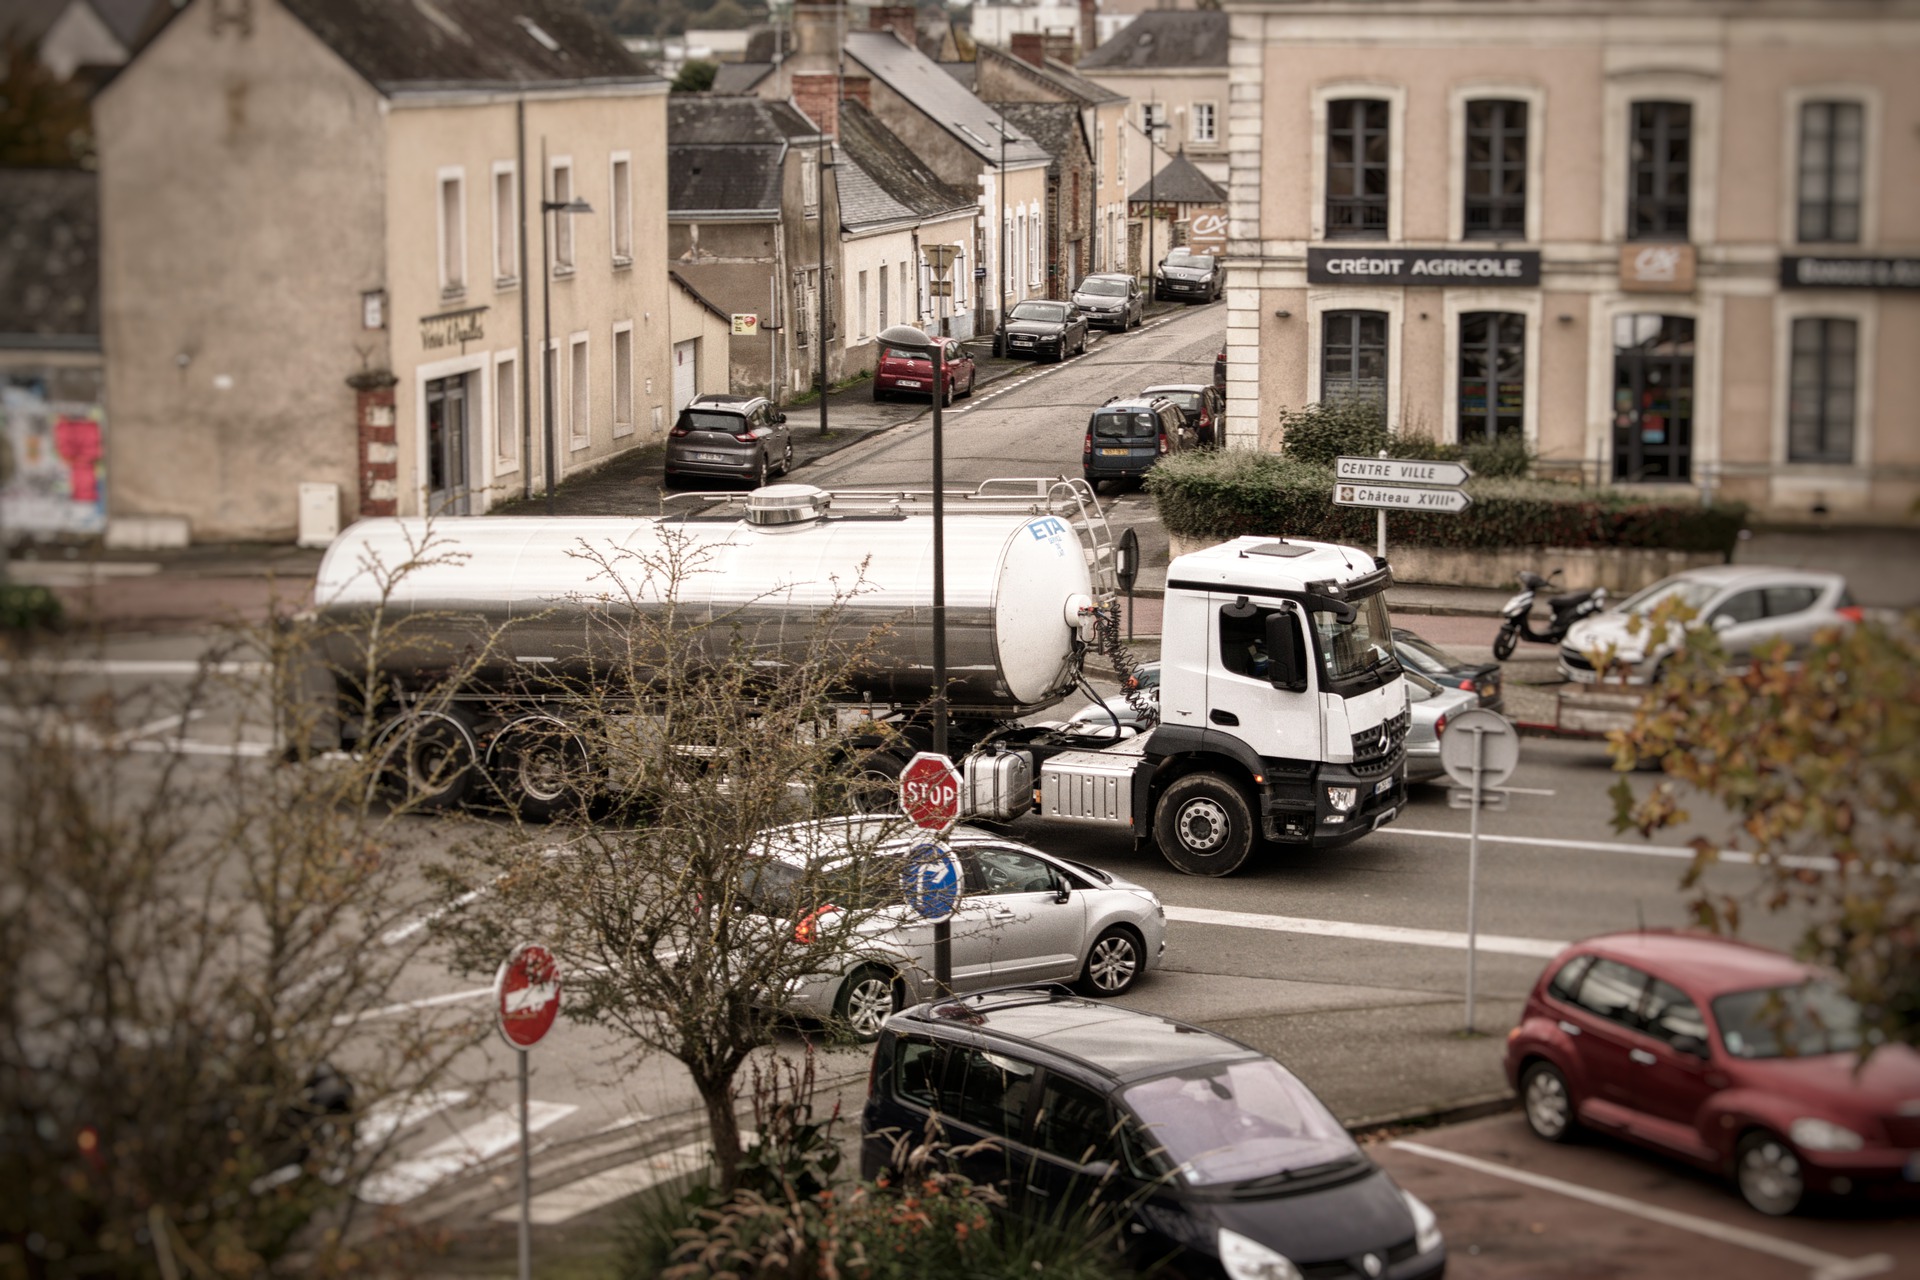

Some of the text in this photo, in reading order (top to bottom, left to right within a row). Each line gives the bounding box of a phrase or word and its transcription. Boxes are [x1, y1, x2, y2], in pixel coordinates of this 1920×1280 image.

[1326, 256, 1523, 278] CRÉDIT AGRICOLE
[1342, 462, 1435, 480] CENTRE VILLE
[1358, 489, 1410, 504] Château
[1027, 517, 1067, 541] ETA
[907, 781, 954, 808] STOP
